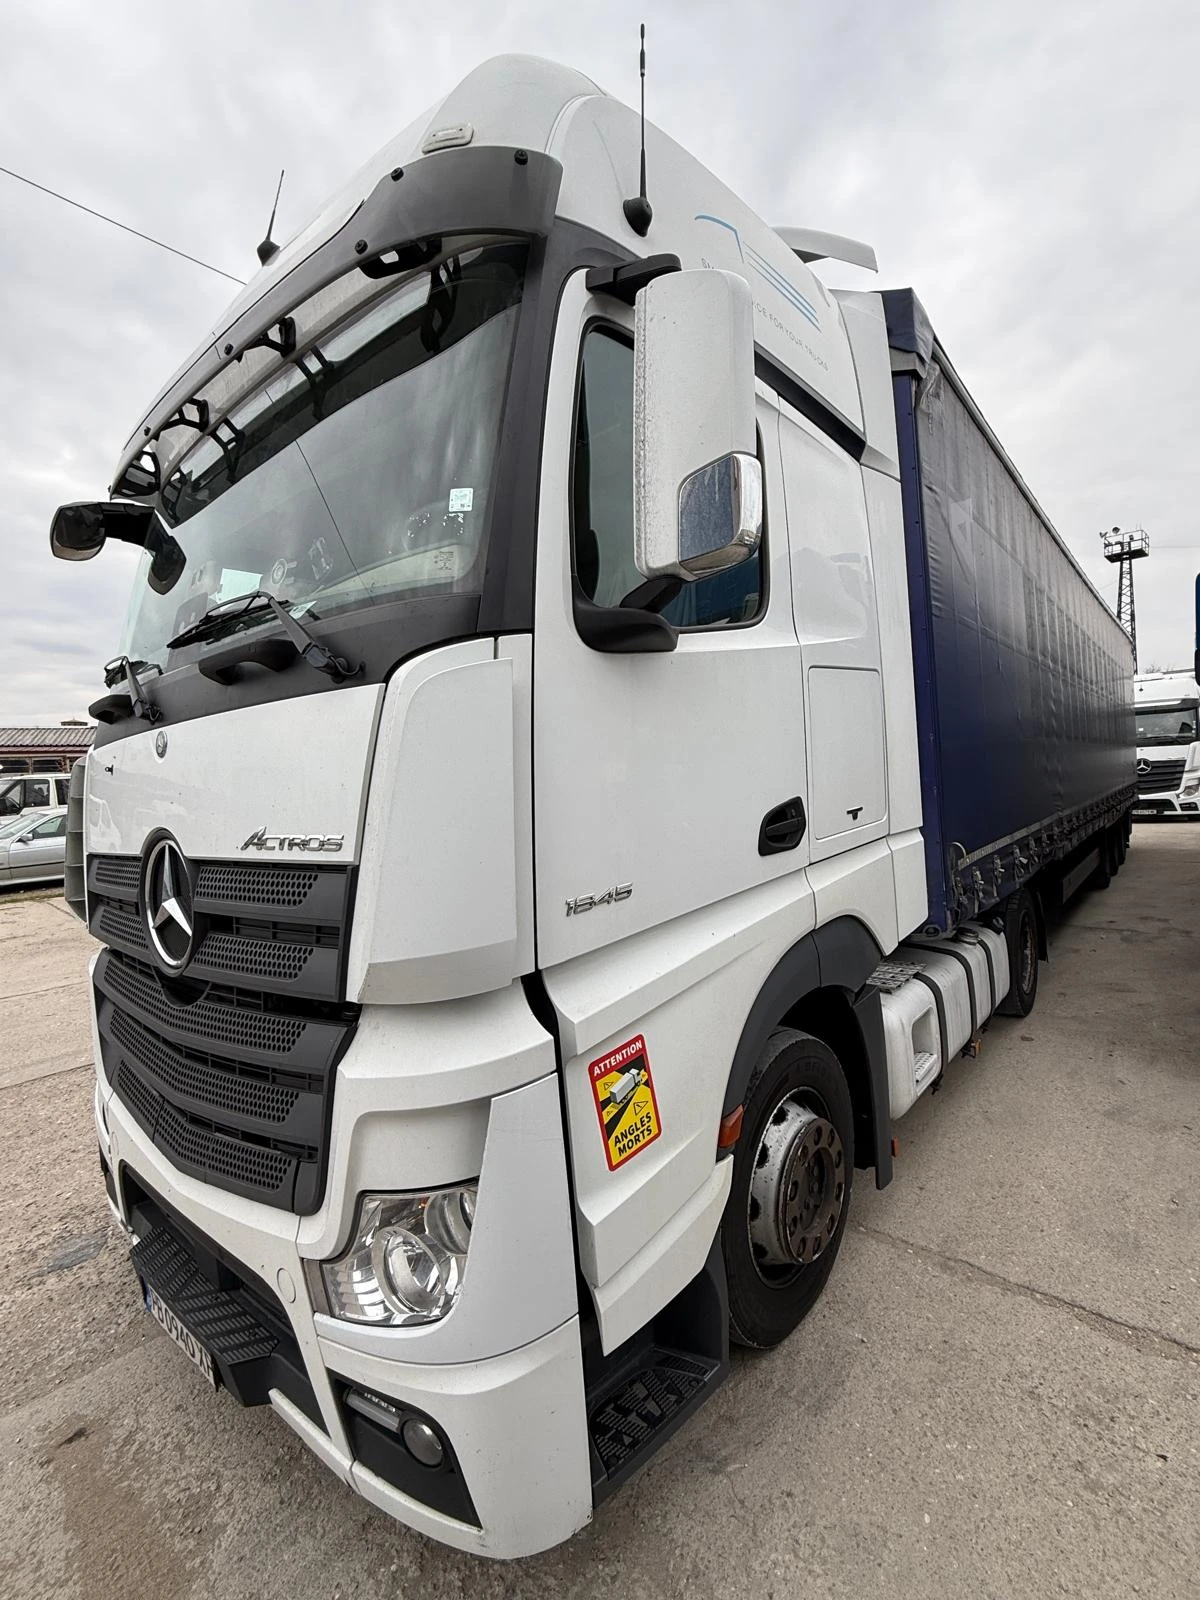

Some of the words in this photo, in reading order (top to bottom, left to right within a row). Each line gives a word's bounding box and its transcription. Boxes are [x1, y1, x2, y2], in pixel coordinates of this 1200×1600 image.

[769, 313, 784, 333] FOR
[785, 328, 804, 350] YOUR
[240, 826, 345, 852] ACTROS
[593, 1040, 643, 1077] ATTENTION
[614, 1111, 652, 1147] ANGLES
[617, 1124, 653, 1157] MORTS
[164, 1306, 195, 1359] 0940
